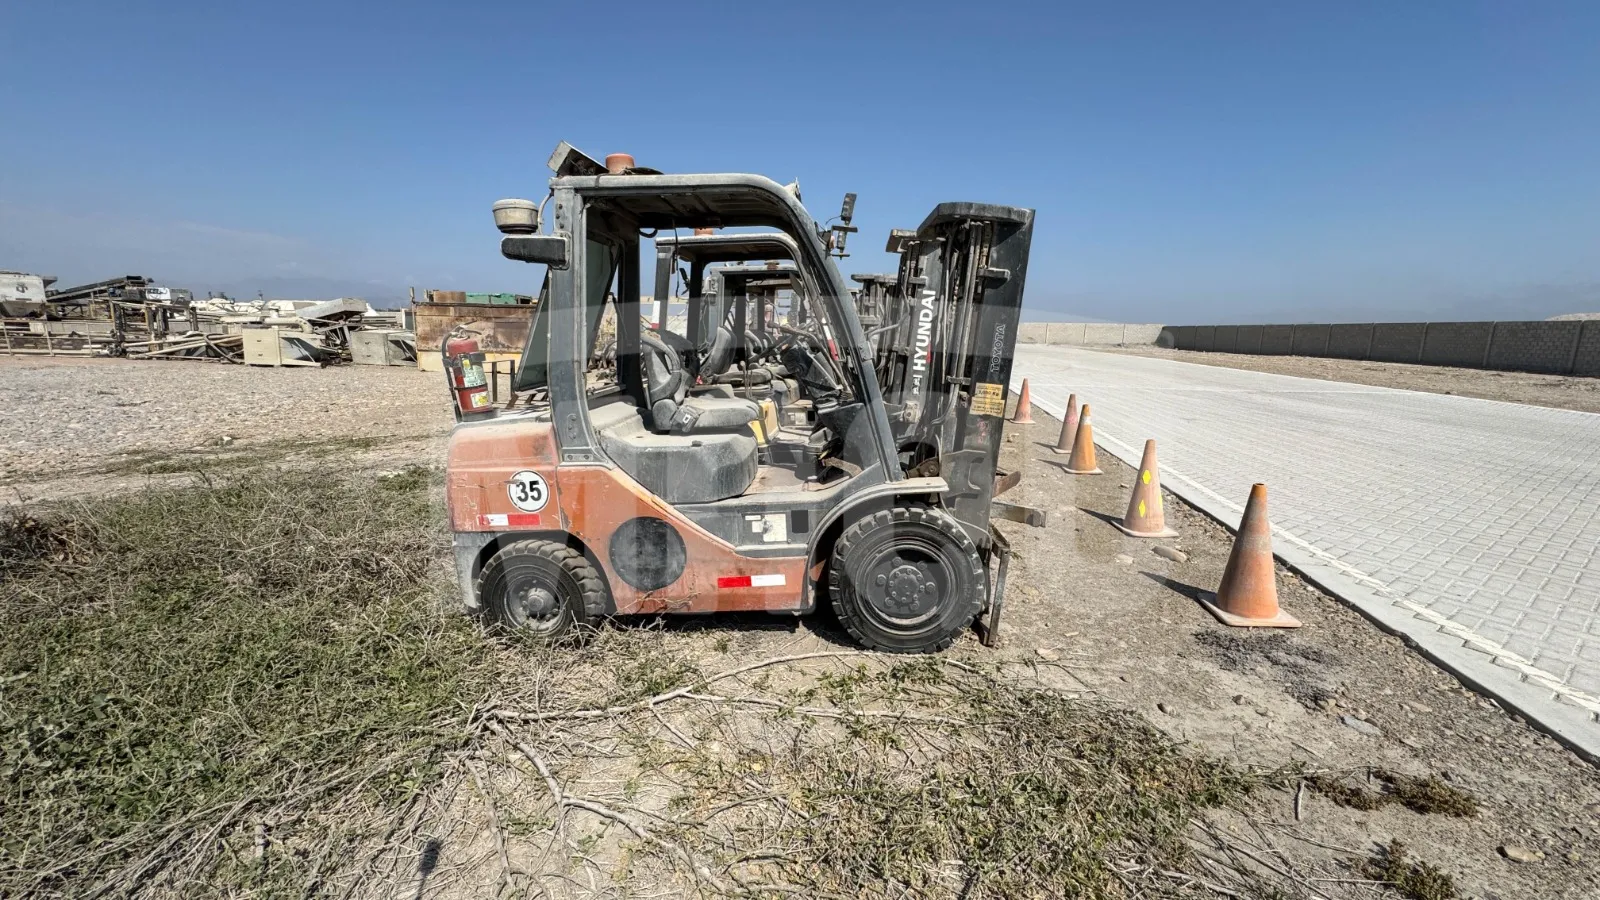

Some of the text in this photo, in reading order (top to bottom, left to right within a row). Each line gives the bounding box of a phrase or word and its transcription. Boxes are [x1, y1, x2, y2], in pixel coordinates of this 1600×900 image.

[913, 289, 937, 371] HYUNDAI
[990, 324, 1006, 372] TOYOTA
[516, 480, 542, 502] 35
